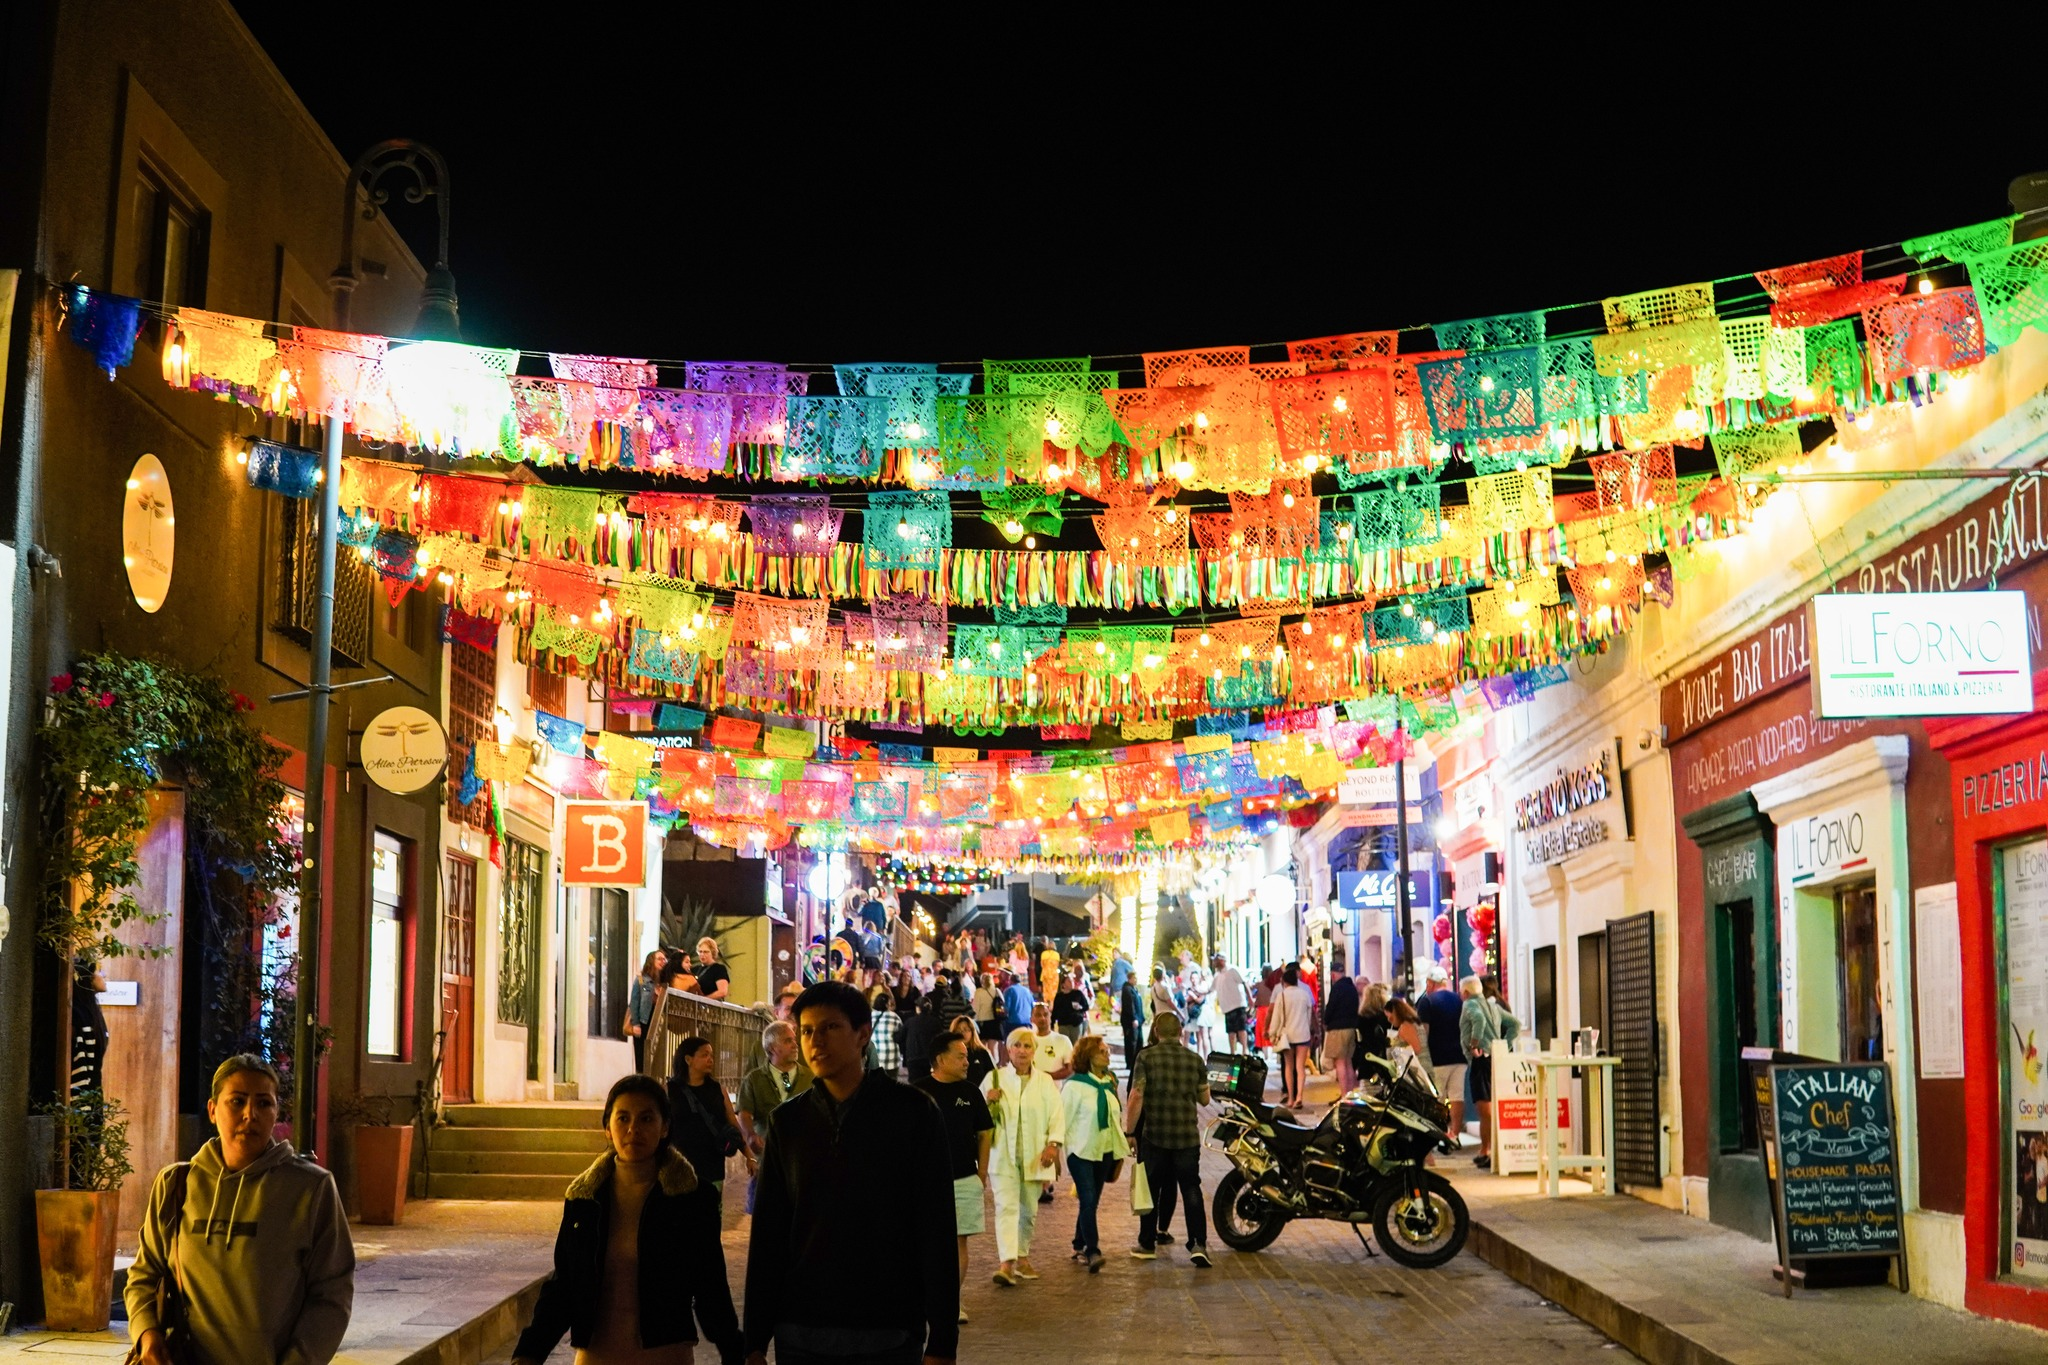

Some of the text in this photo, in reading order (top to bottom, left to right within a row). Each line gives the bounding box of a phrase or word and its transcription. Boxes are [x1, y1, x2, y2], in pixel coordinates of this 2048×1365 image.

[1872, 611, 2004, 665] FORNO
[1680, 662, 1724, 733] WINE
[1732, 641, 1763, 703] BAR
[1850, 681, 2003, 698] RISTORANTE ITALIANO & PIZZERIA
[1687, 750, 1726, 795] HOMEMADE
[1963, 750, 2048, 819] PIZZERIA
[580, 815, 627, 873] B
[1793, 811, 1863, 870] IL FORNO
[1787, 1071, 1876, 1108] ITALIAN
[1810, 1100, 1852, 1130] Chef
[1785, 1164, 1891, 1178] HOUSEMADE PASTA
[1793, 1225, 1898, 1242] Fish Steak Salmon
